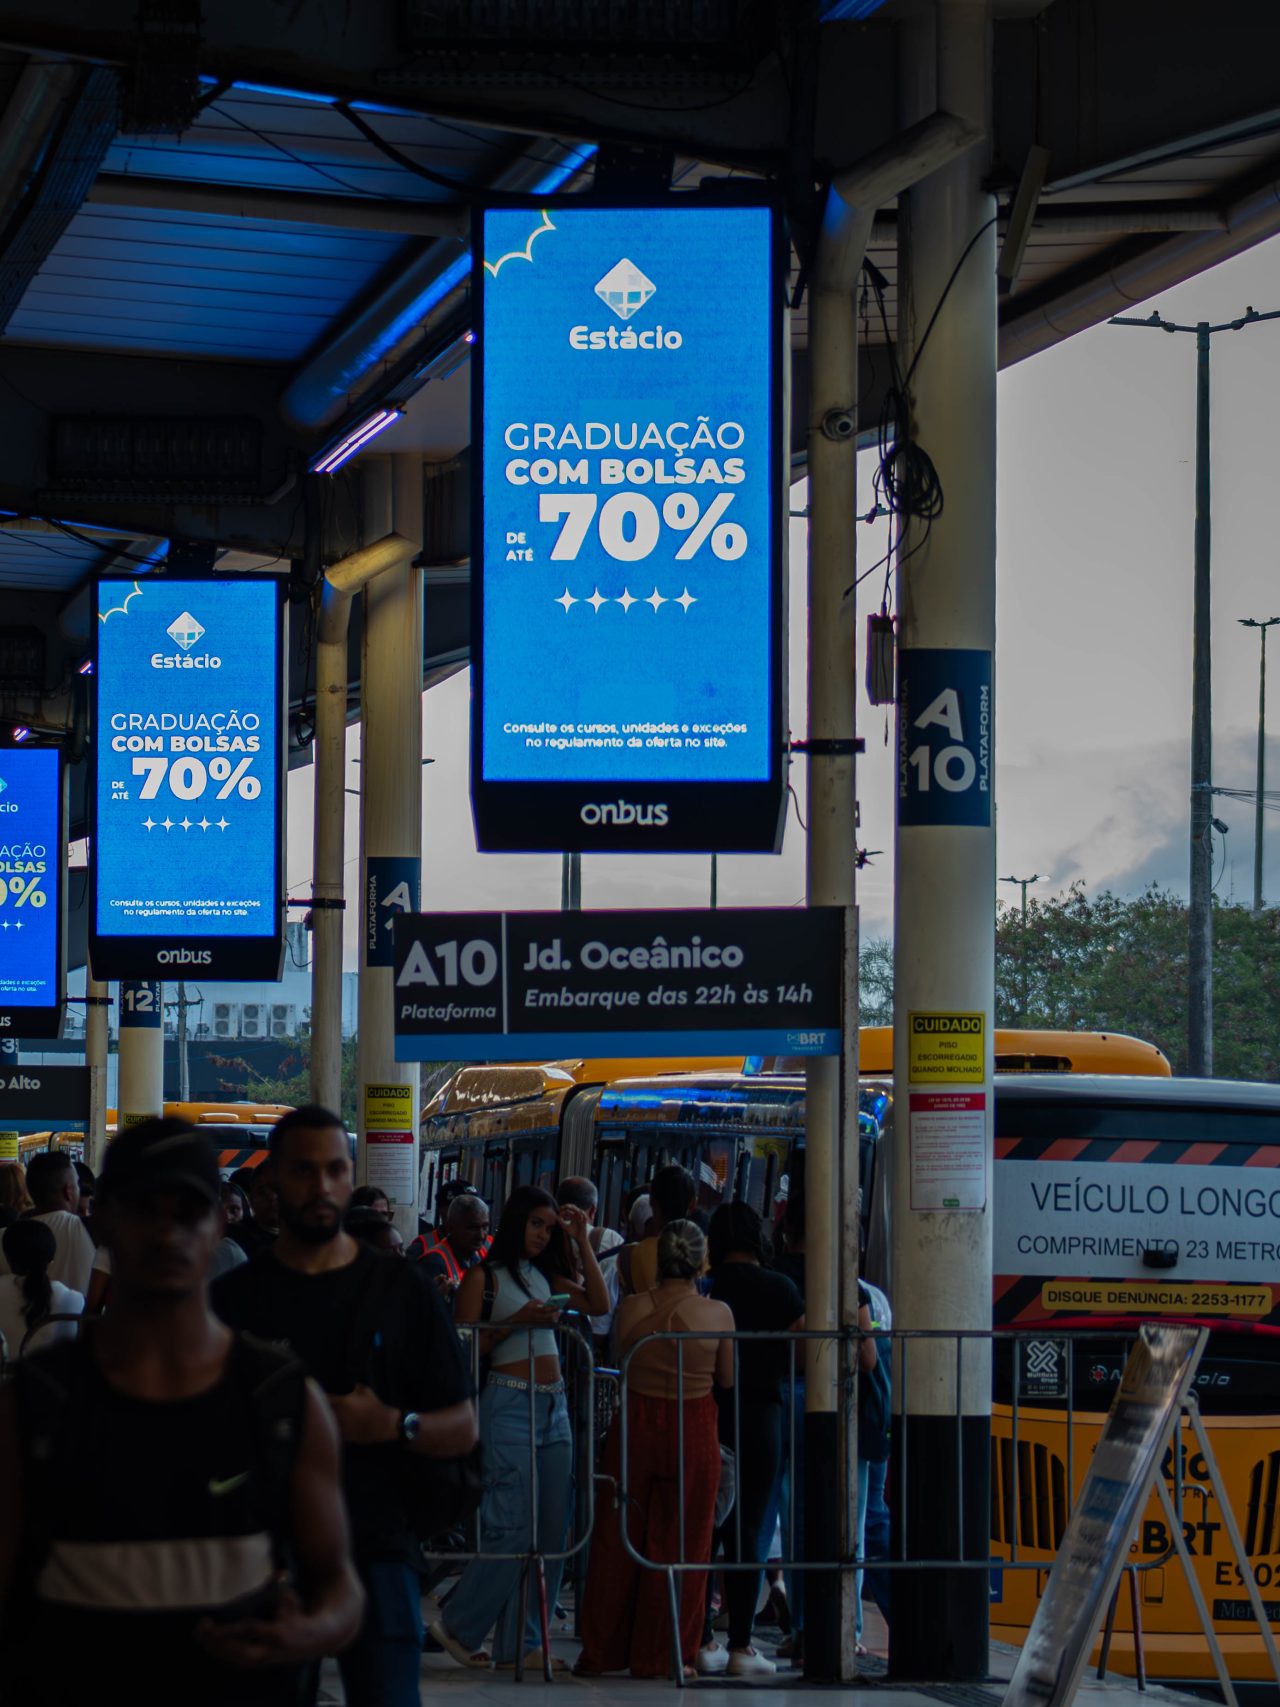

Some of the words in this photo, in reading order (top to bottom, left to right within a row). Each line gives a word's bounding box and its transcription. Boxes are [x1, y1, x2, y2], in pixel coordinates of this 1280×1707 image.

[569, 325, 682, 349] Estácio
[505, 416, 744, 456] GRADUAÇÃO
[506, 459, 588, 485] COM
[601, 459, 745, 484] BOLSAS
[506, 532, 526, 544] DE
[539, 492, 747, 561] 70%
[506, 548, 533, 561] ATÉ
[151, 653, 221, 668] Estácio
[111, 710, 259, 735] GRADUAÇÃO
[913, 687, 964, 743] A
[503, 723, 557, 733] Consulte
[560, 724, 574, 733] os
[622, 723, 679, 733] unidades
[681, 724, 688, 733] e
[112, 736, 163, 752] COM
[171, 736, 260, 752] BOLSAS
[526, 738, 542, 747] no
[545, 737, 624, 749] regulamento
[627, 737, 642, 747] da
[645, 737, 682, 748] oferta
[685, 738, 701, 747] no
[132, 757, 261, 800] 70%
[908, 745, 977, 792] 10
[112, 781, 124, 789] DE
[112, 791, 128, 799] ATÉ
[581, 800, 668, 826] onbus
[380, 881, 412, 913] A
[369, 875, 377, 950] PLATAFORMA
[157, 948, 211, 964] onbus
[396, 940, 497, 986] A10
[524, 939, 571, 970] Jd.
[581, 936, 743, 969] Oceânico
[124, 989, 153, 1012] 12
[401, 1003, 496, 1021] Plataforma
[525, 987, 640, 1010] Embarque
[648, 985, 687, 1005] das
[695, 984, 735, 1004] 22h
[744, 983, 768, 1003] às
[777, 983, 812, 1003] 14h
[915, 1019, 980, 1031] CUIDADO
[799, 1033, 825, 1044] BRT
[8, 1075, 41, 1090] Alto
[368, 1088, 410, 1098] CUIDADO
[1031, 1177, 1169, 1214] VEÍCULO
[1017, 1236, 1180, 1257] COMPRIMENTO
[1186, 1240, 1209, 1259] 23
[1048, 1291, 1101, 1303] DISQUE
[1107, 1290, 1188, 1305] DENÚNCIA:
[1192, 1293, 1266, 1307] 2253-1177
[1143, 1520, 1220, 1556] BRT
